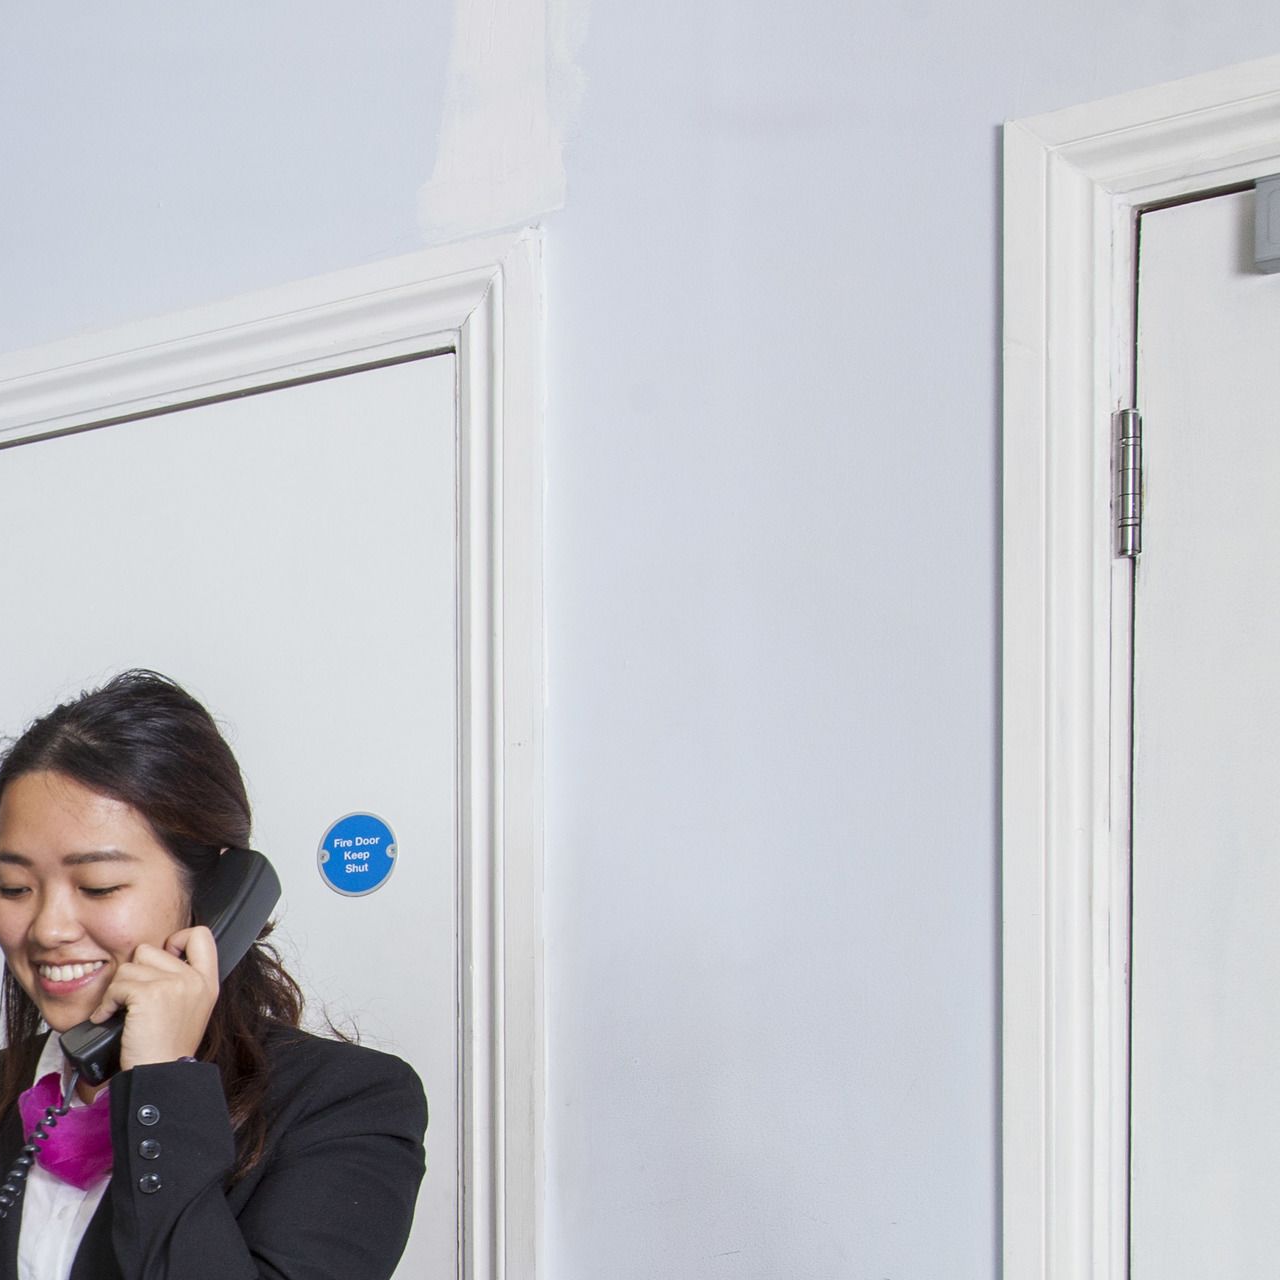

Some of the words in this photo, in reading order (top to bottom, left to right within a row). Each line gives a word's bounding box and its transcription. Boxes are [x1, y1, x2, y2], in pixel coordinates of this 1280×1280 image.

[334, 838, 352, 848] Fire
[355, 837, 380, 846] Door
[344, 851, 370, 861] Keep
[345, 863, 368, 873] Shut
